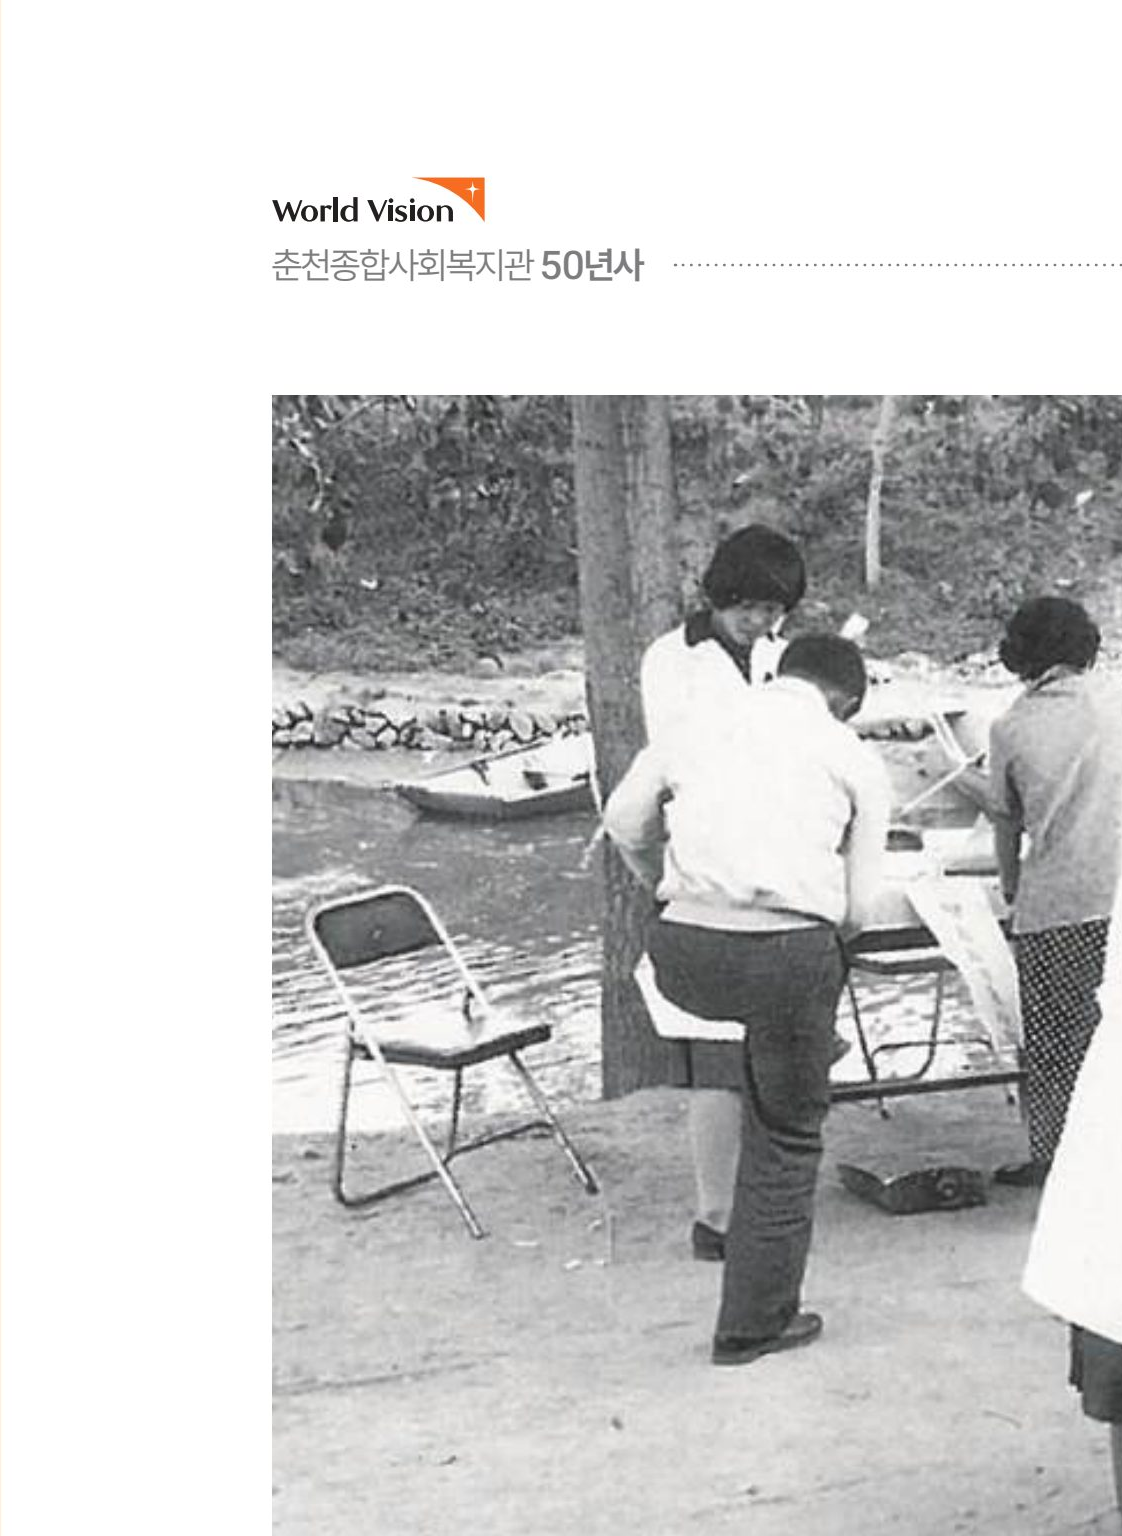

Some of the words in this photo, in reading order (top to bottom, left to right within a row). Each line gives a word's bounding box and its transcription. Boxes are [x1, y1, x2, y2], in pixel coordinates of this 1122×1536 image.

[272, 197, 359, 223] World
[367, 197, 454, 223] Vision
[271, 248, 535, 282] 춘천종합사회복지관
[541, 247, 645, 282] 50년사
